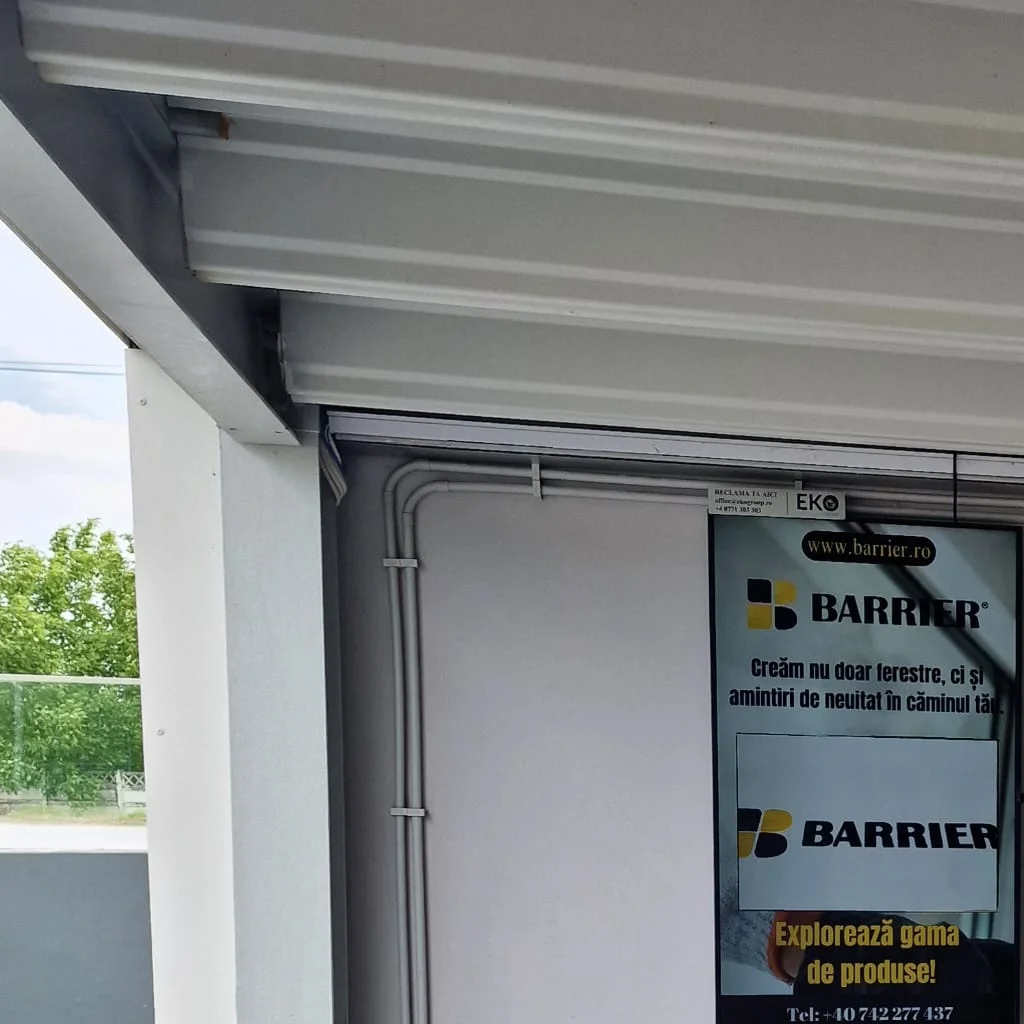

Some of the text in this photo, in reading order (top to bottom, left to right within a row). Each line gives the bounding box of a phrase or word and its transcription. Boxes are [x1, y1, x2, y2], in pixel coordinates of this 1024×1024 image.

[807, 538, 931, 560] www.barrier.ro
[751, 657, 804, 679] Creăm
[809, 662, 830, 681] nu
[834, 661, 871, 682] doar
[877, 662, 945, 686] ferestre,
[950, 665, 966, 685] ci
[729, 687, 795, 708] amintiri
[799, 688, 820, 709] de
[825, 690, 882, 711] neuitat
[884, 690, 902, 712] în
[906, 691, 970, 713] căminul
[802, 819, 998, 850] BARRIER
[775, 919, 960, 951] Explorează gama
[807, 959, 937, 988] de produse!
[787, 1006, 954, 1022] Tel: +40 742 277 437
